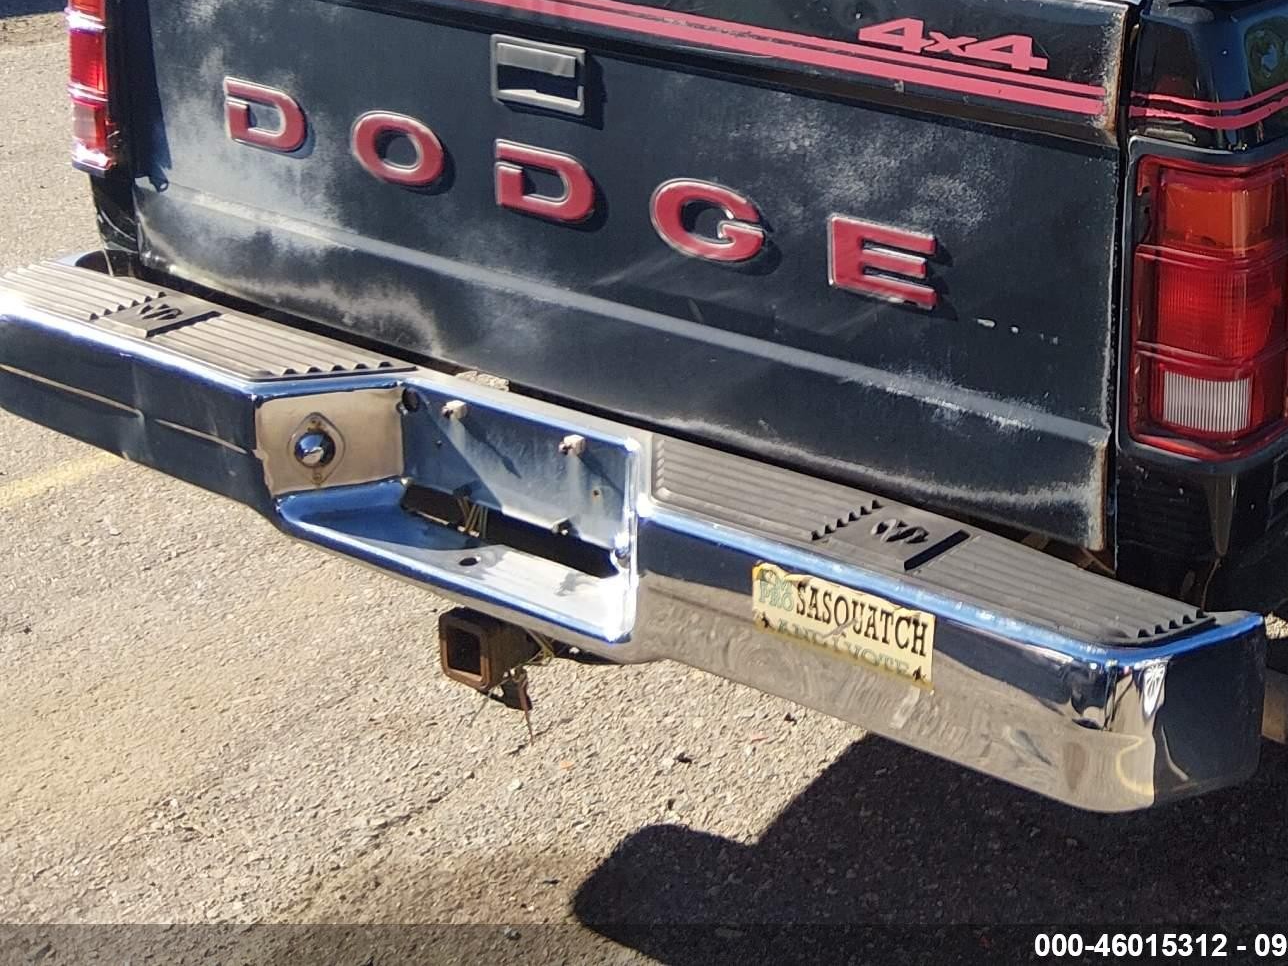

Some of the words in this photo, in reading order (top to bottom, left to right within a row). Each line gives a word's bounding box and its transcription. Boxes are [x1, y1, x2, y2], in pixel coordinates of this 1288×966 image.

[858, 17, 1049, 72] 4x4
[223, 76, 939, 310] DODGE
[796, 581, 929, 657] SASQUATCH
